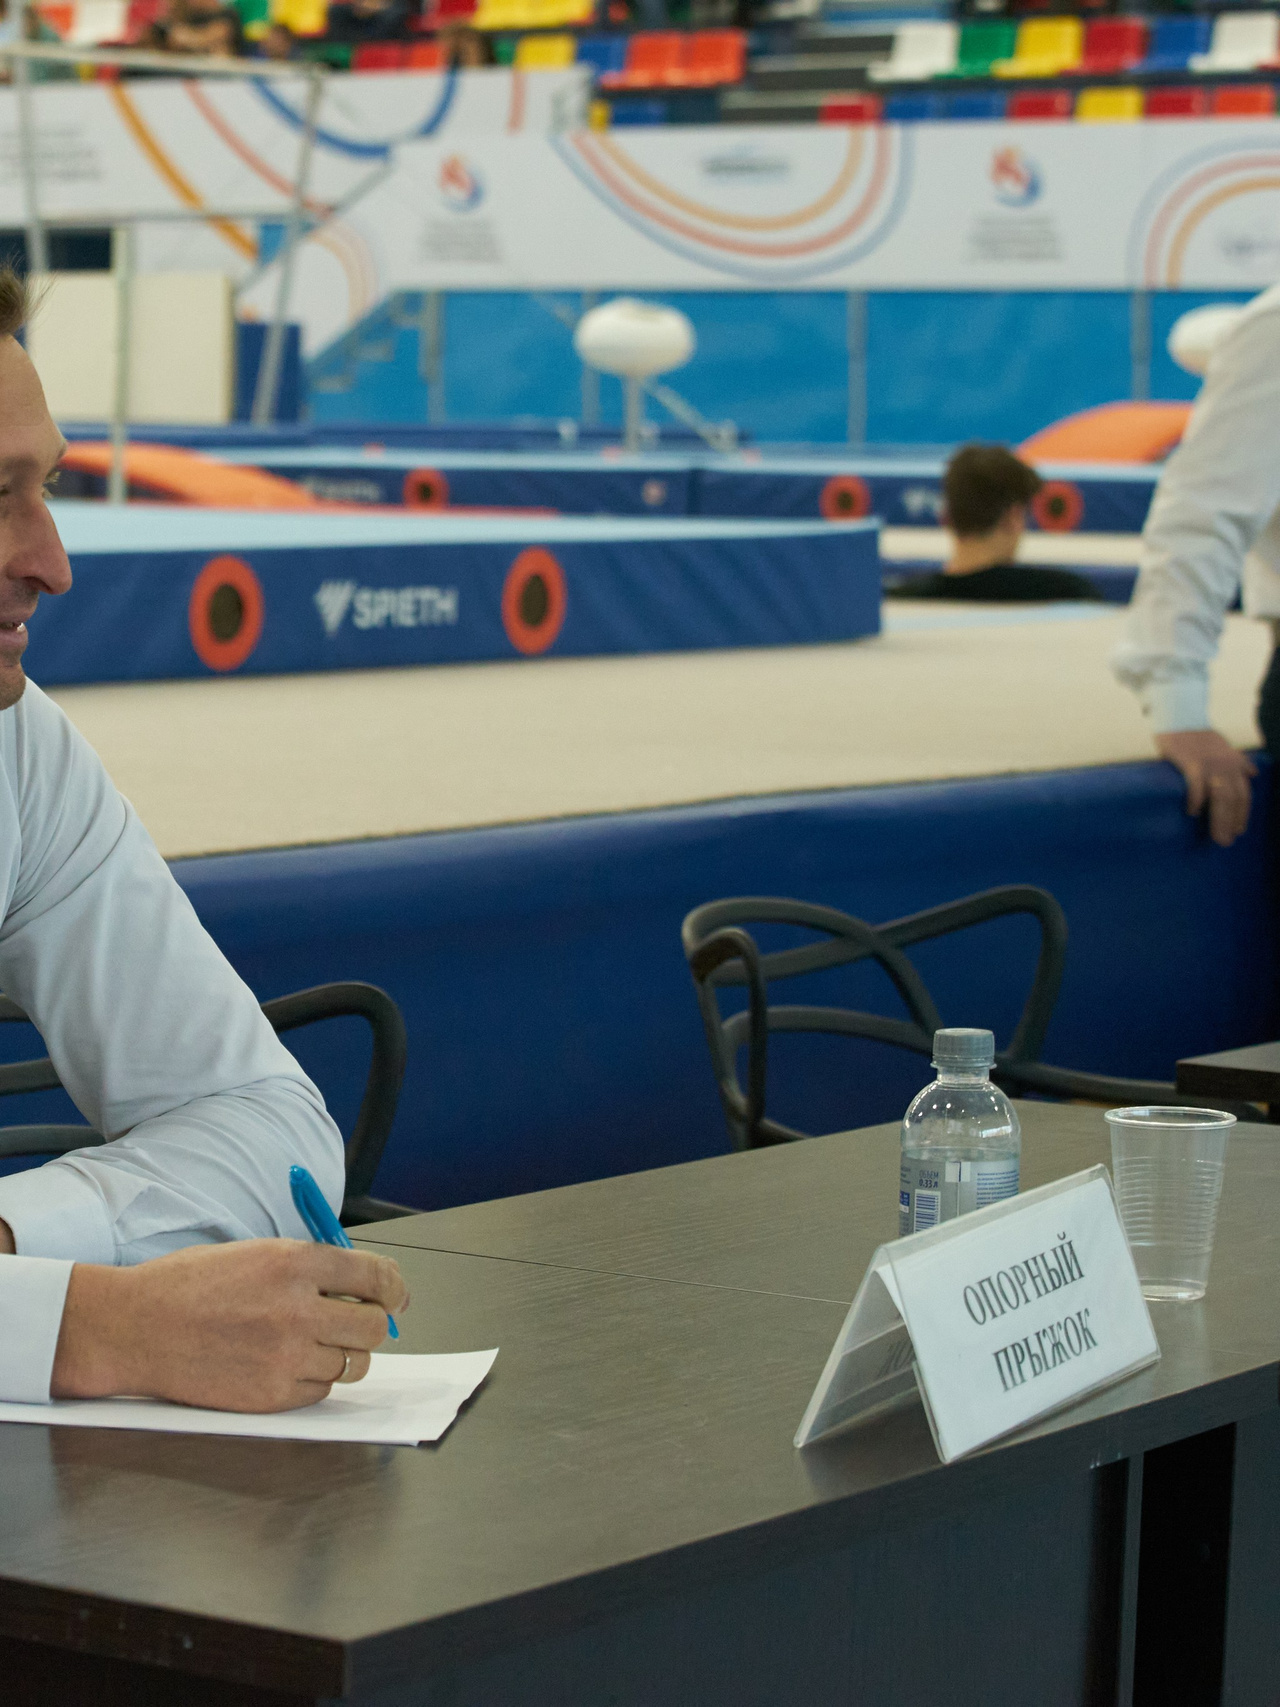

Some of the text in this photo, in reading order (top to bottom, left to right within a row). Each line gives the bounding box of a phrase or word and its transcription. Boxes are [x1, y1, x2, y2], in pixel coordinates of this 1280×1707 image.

[353, 585, 459, 629] SPIETH
[963, 1231, 1085, 1325] ОПОРНЫЙ
[992, 1307, 1098, 1392] ПРЫЖОК
